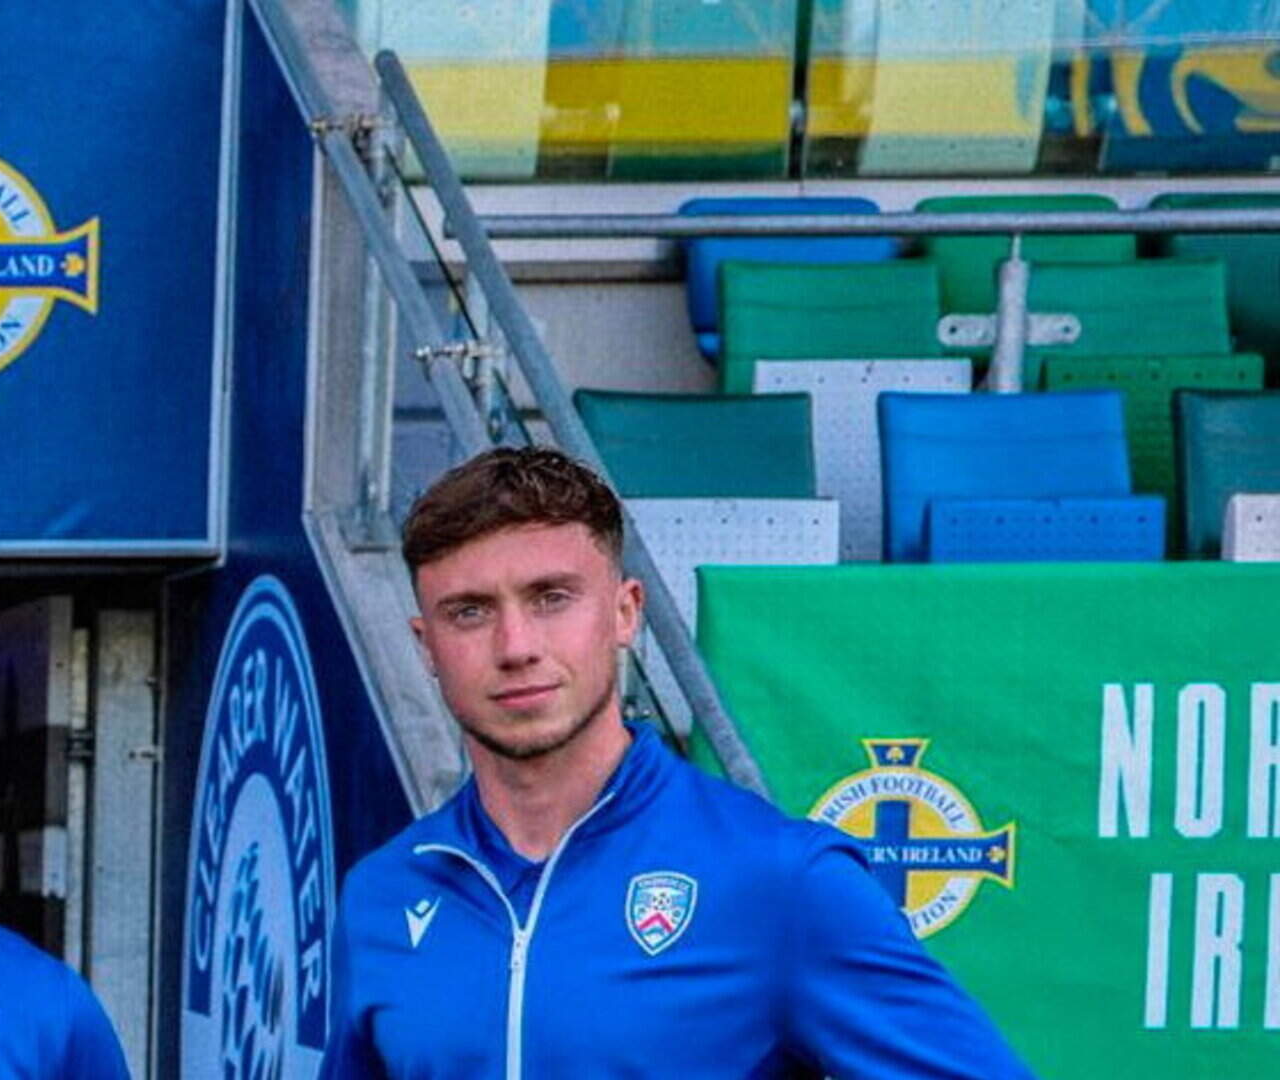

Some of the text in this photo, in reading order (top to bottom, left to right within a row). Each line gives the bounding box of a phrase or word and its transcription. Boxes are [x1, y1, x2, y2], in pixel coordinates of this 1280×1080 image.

[870, 775, 967, 830] FOOTBALL
[194, 647, 322, 1014] CLEARER WATER
[902, 846, 983, 864] IRELAND
